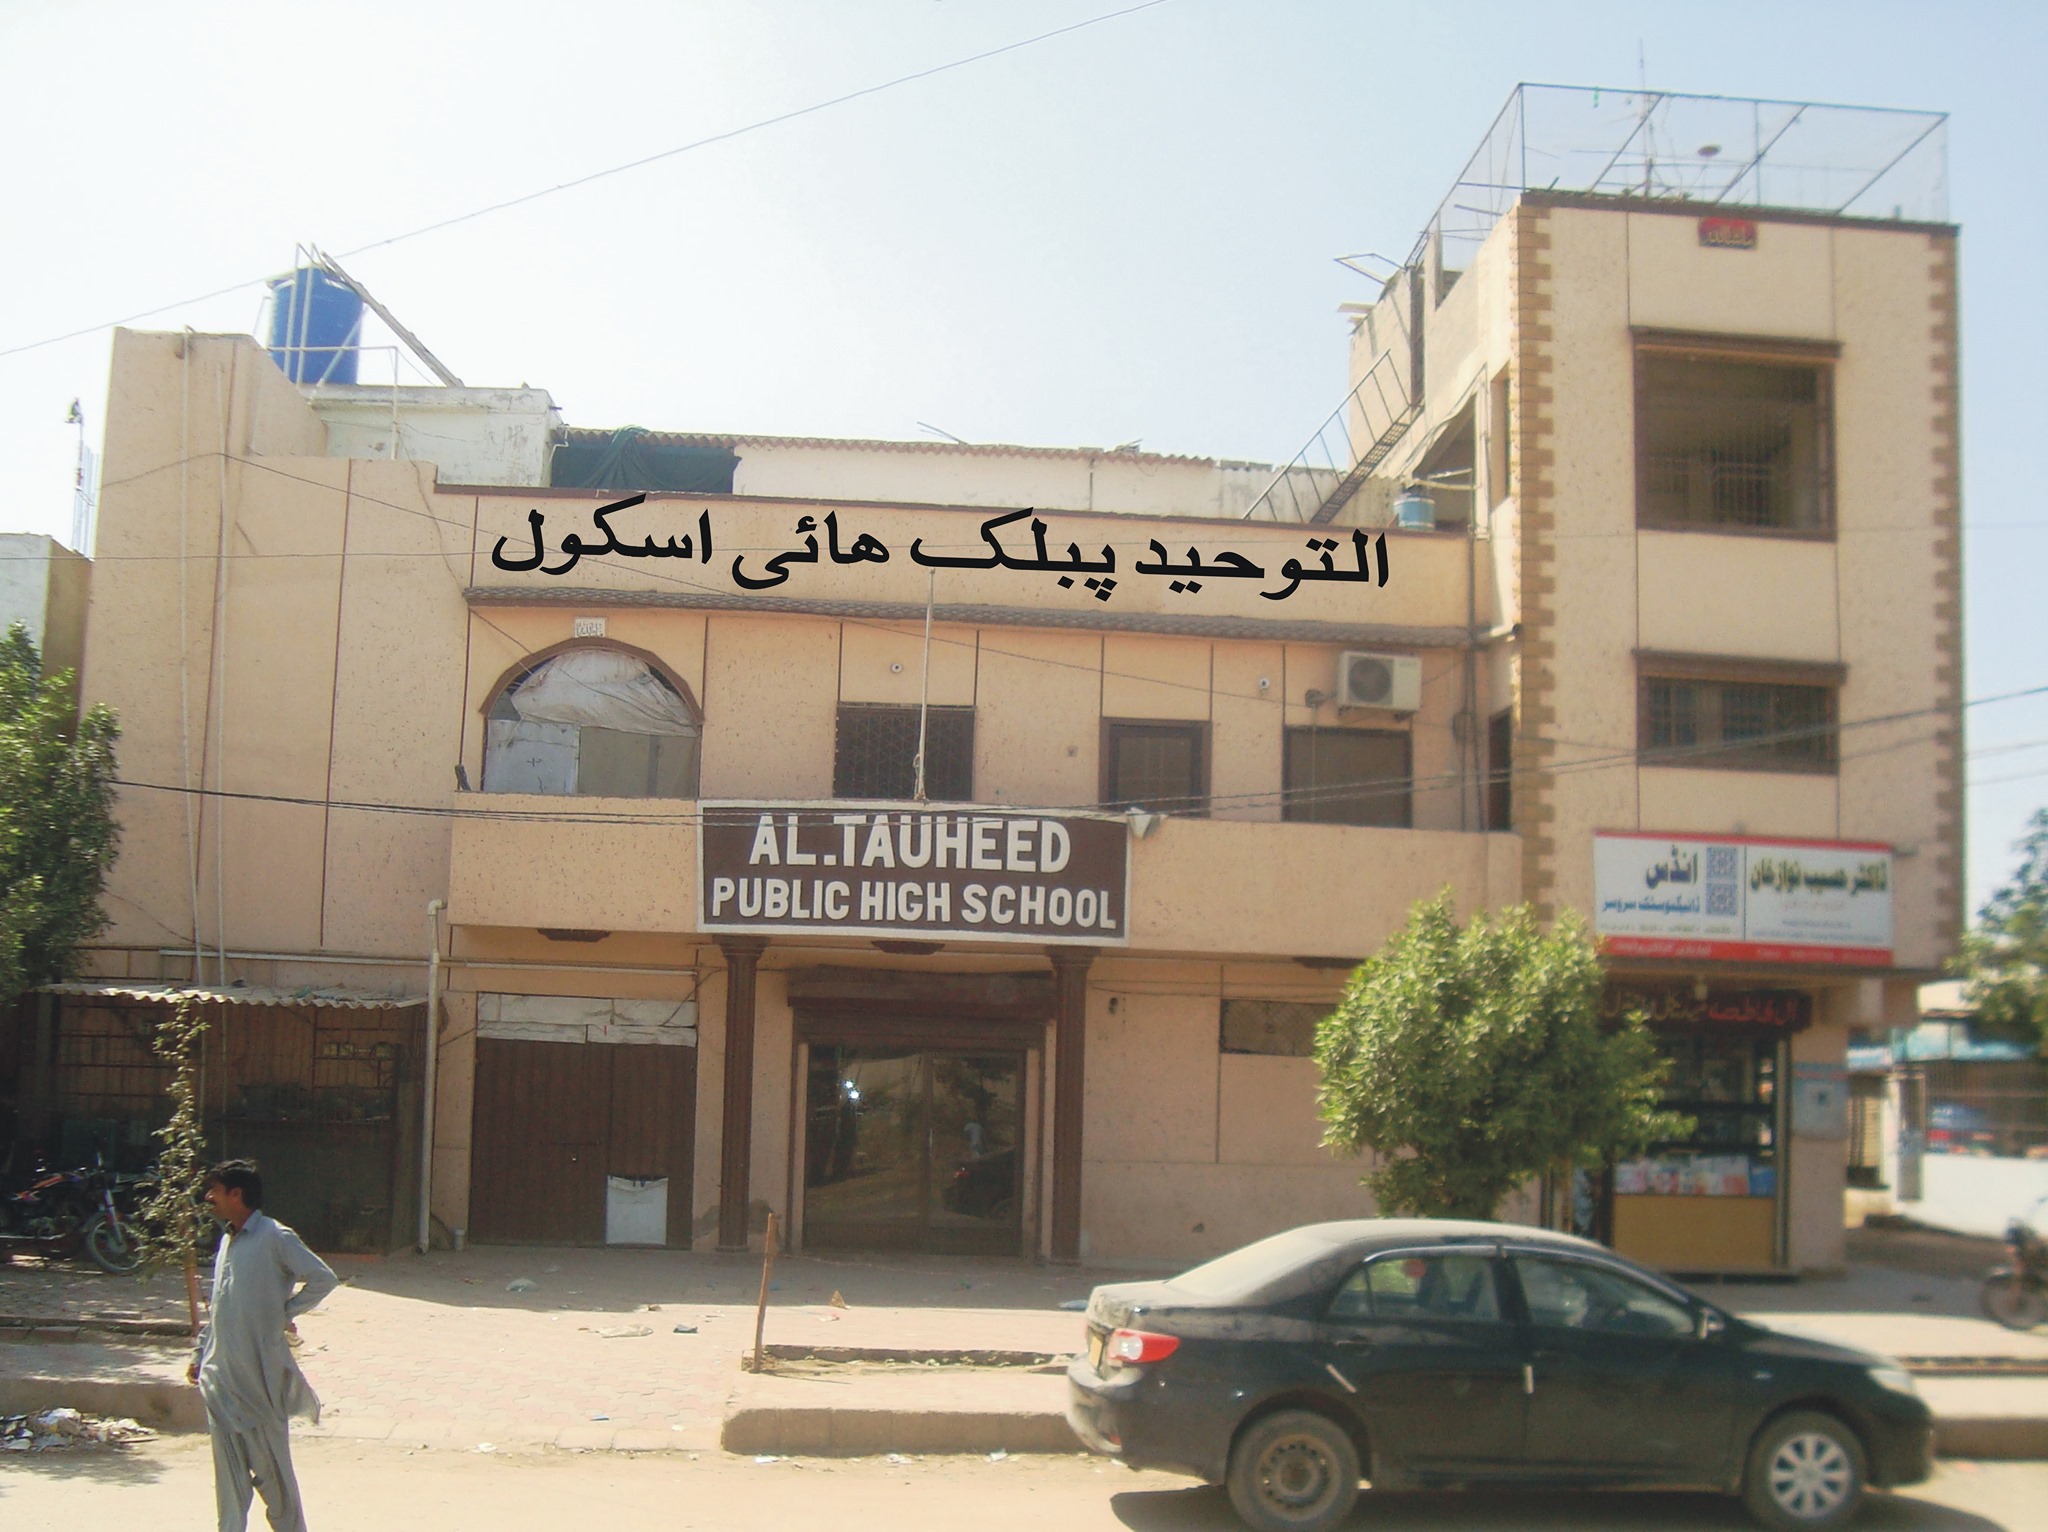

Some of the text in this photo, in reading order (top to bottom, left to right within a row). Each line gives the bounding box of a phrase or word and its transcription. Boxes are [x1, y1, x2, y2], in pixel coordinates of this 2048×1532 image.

[748, 813, 1071, 874] AL.TAUHEED
[1646, 844, 1698, 889] انڈس
[711, 877, 1117, 931] PUBLIC HIGH SCHOOL
